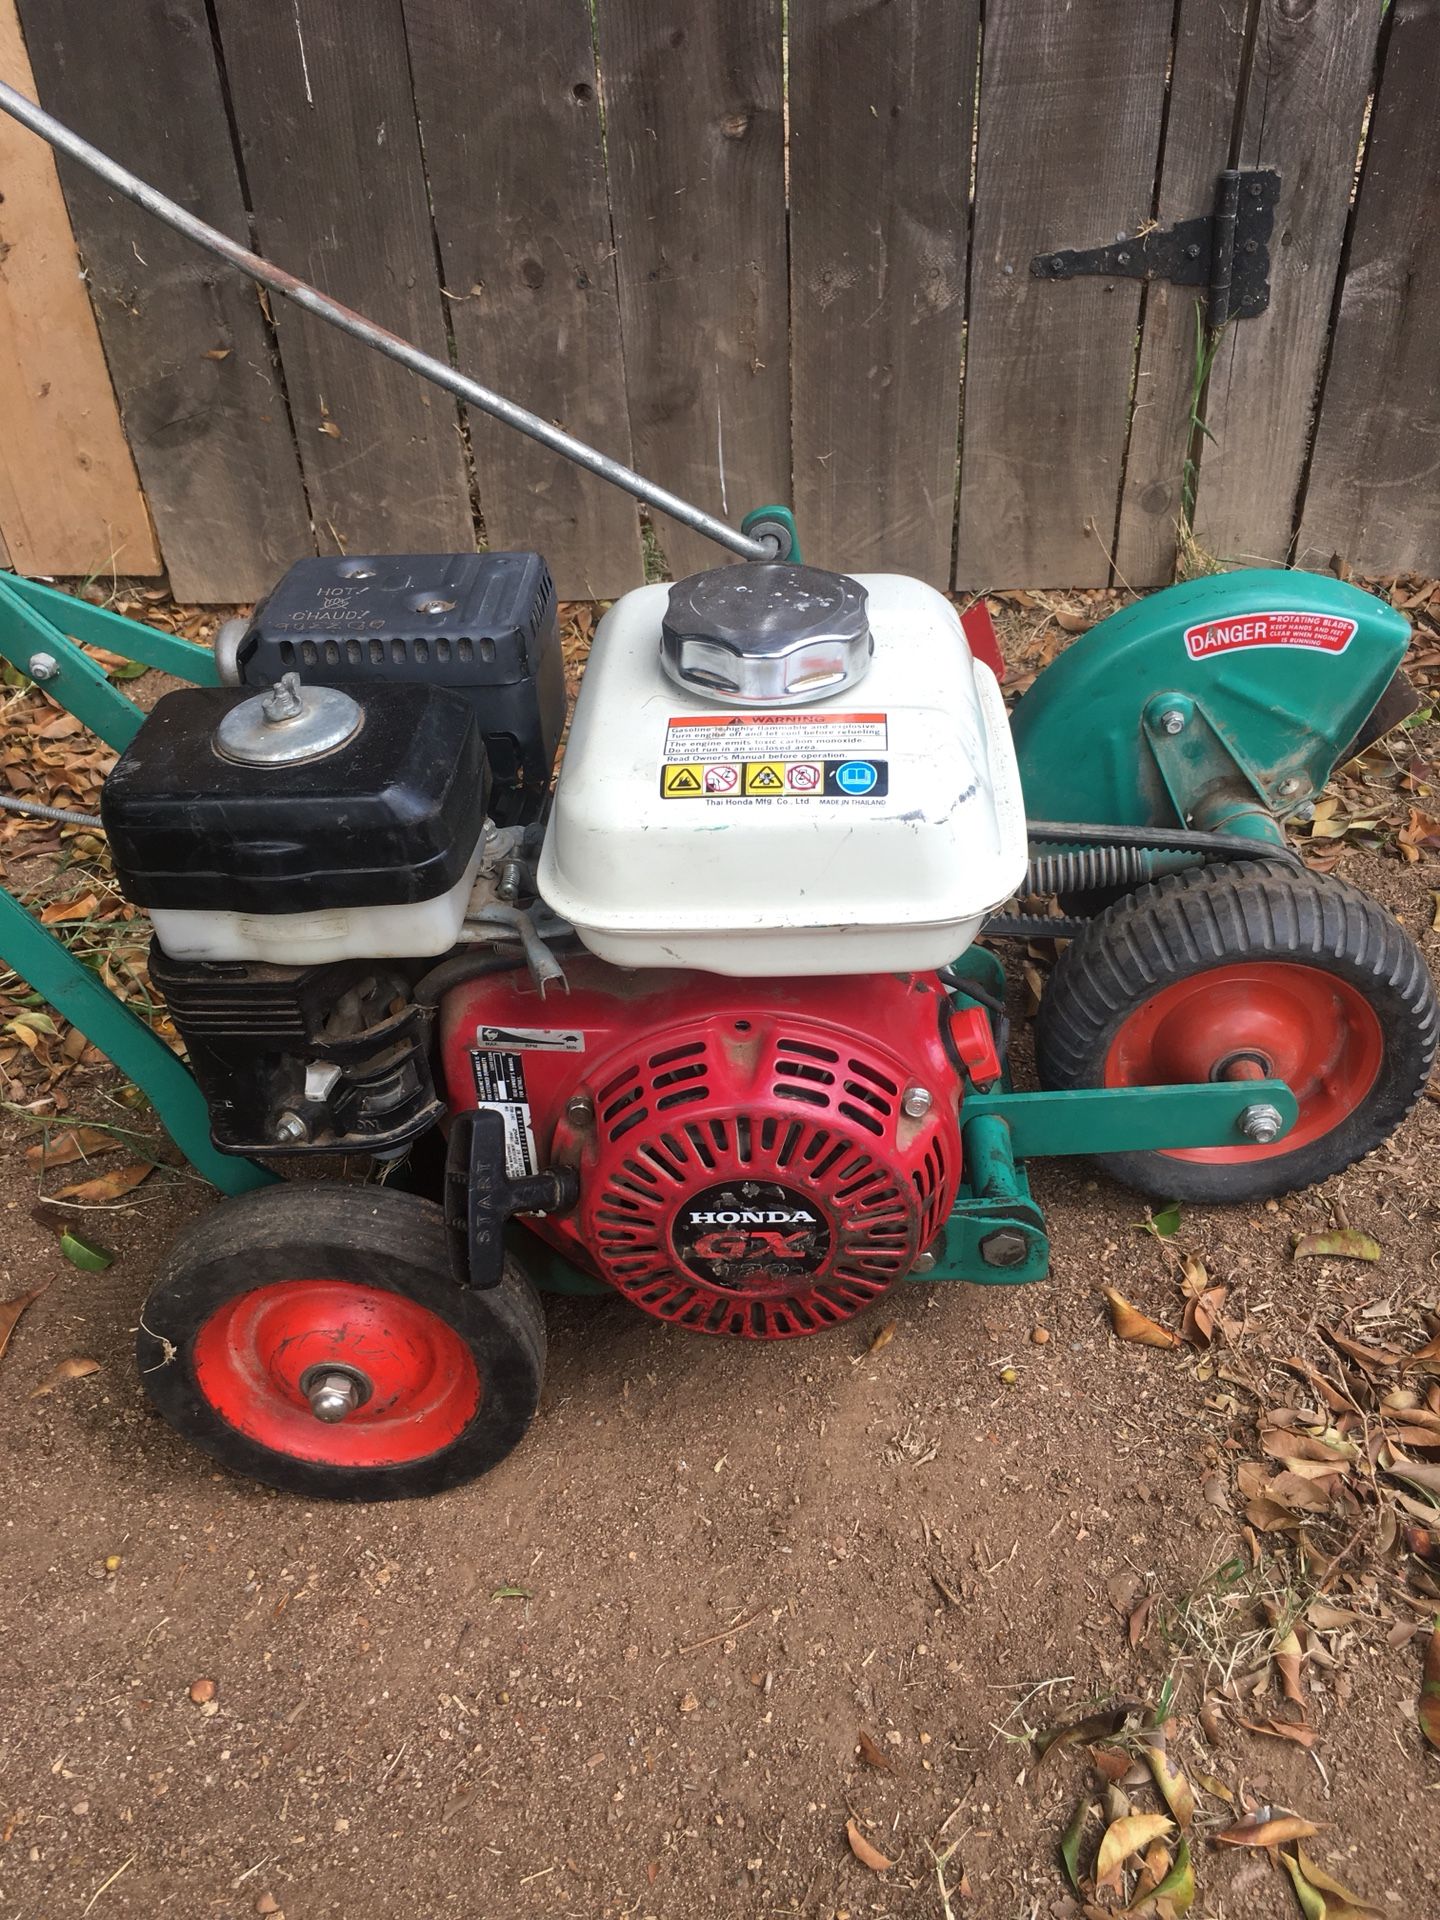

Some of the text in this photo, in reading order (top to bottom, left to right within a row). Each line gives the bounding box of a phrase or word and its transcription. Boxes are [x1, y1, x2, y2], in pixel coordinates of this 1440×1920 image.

[317, 586, 370, 596] HOT!
[291, 610, 371, 620] CHAUD!
[1277, 615, 1348, 629] ROTATING BLADE
[1190, 621, 1268, 652] DANGER
[1289, 638, 1321, 646] RUNNING
[1314, 633, 1338, 643] ENGINE
[476, 1160, 492, 1246] START
[689, 1210, 817, 1224] HONDA
[694, 1231, 812, 1259] GX
